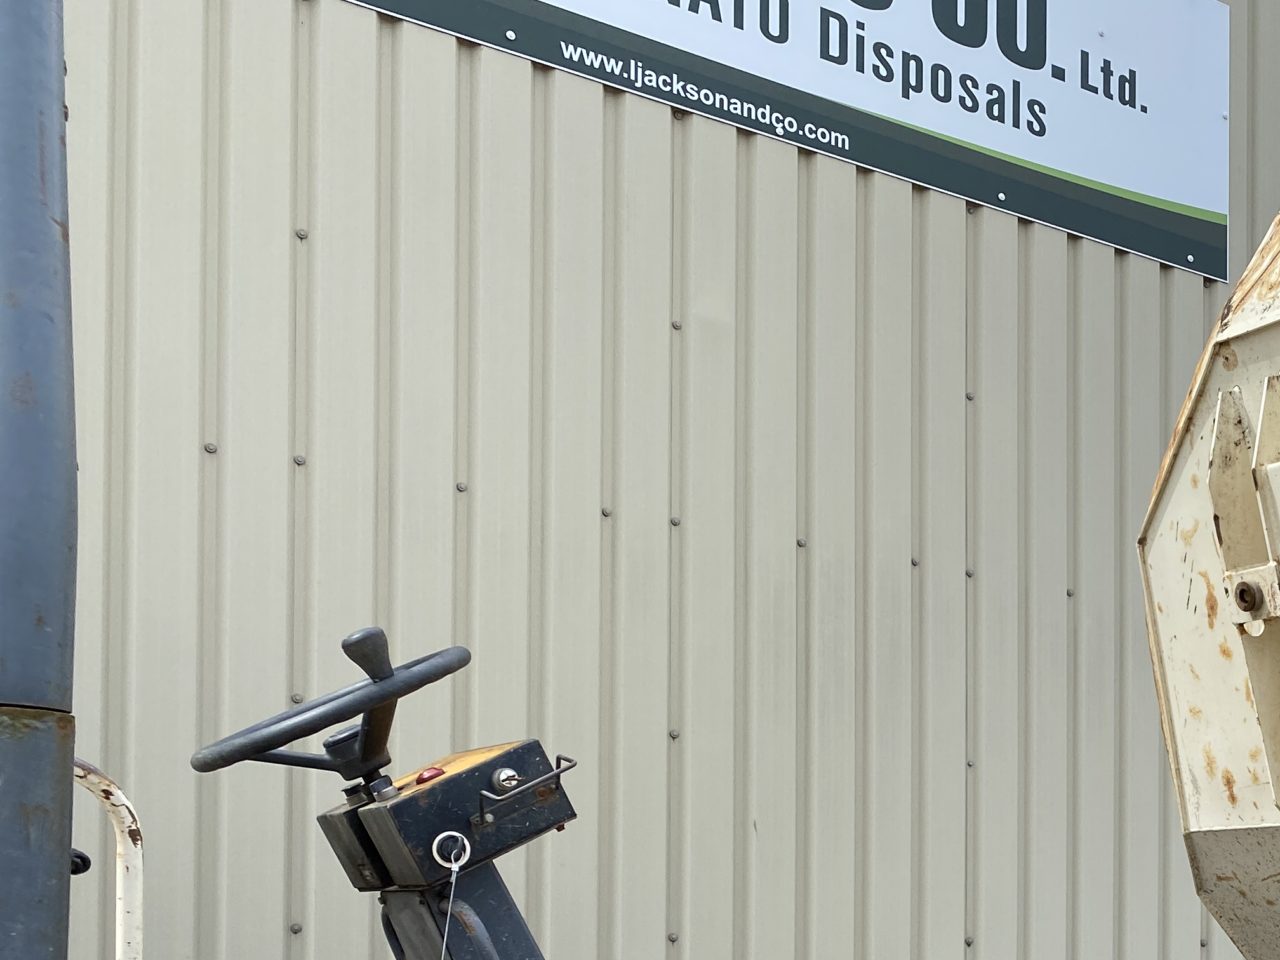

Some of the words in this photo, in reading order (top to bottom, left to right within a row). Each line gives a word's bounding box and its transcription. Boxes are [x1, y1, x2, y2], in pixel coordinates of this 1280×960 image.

[559, 40, 850, 151] www.ljacksonandco.com
[819, 6, 1047, 138] Disposals
[1079, 49, 1149, 114] Ltd.
